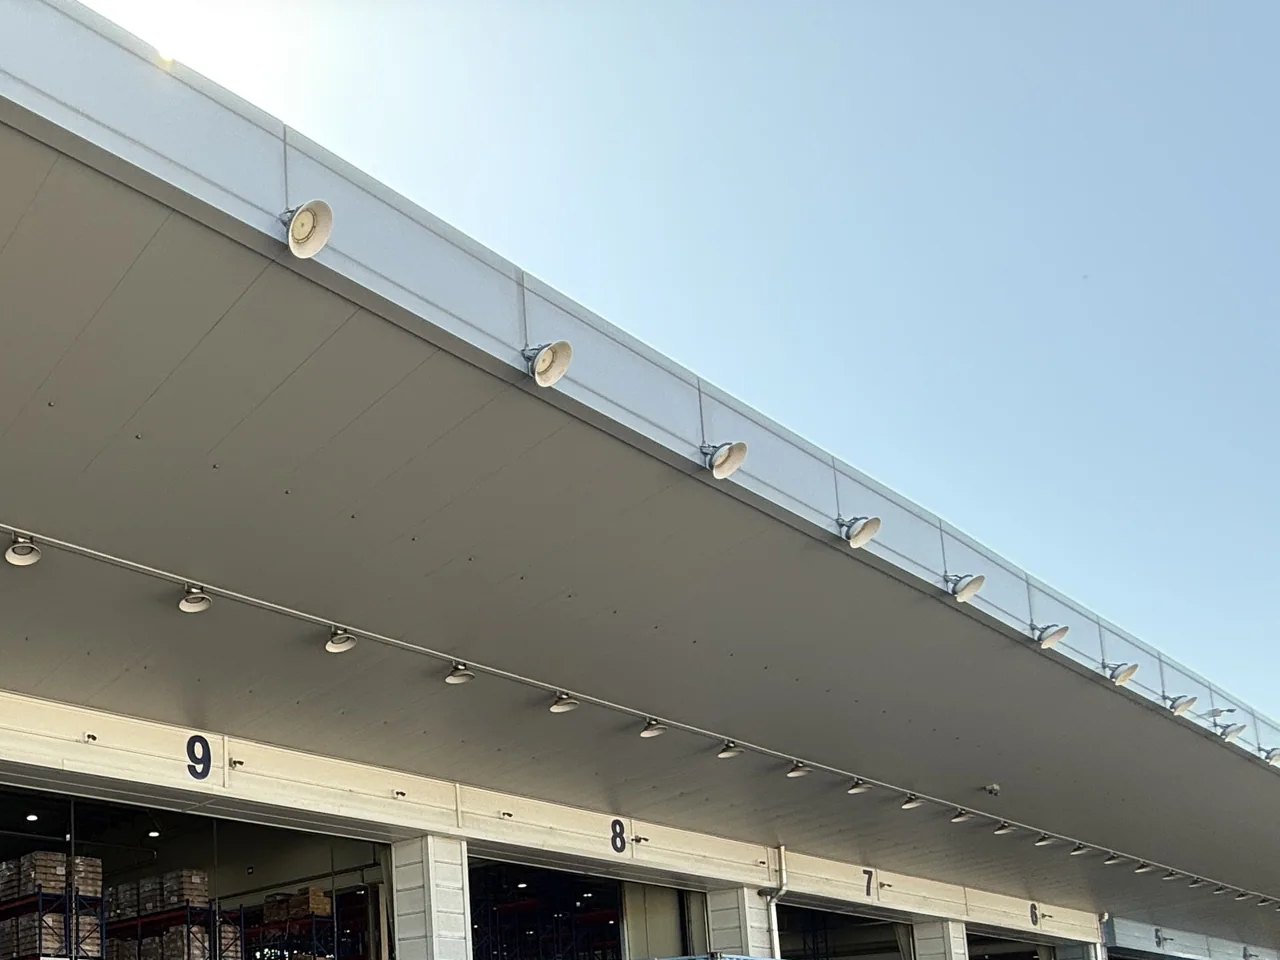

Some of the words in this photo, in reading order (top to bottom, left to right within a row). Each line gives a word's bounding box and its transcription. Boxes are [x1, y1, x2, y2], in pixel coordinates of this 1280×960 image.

[186, 735, 212, 780] 9
[611, 819, 626, 853] 8
[862, 869, 873, 897] 7
[1030, 903, 1039, 926] 6
